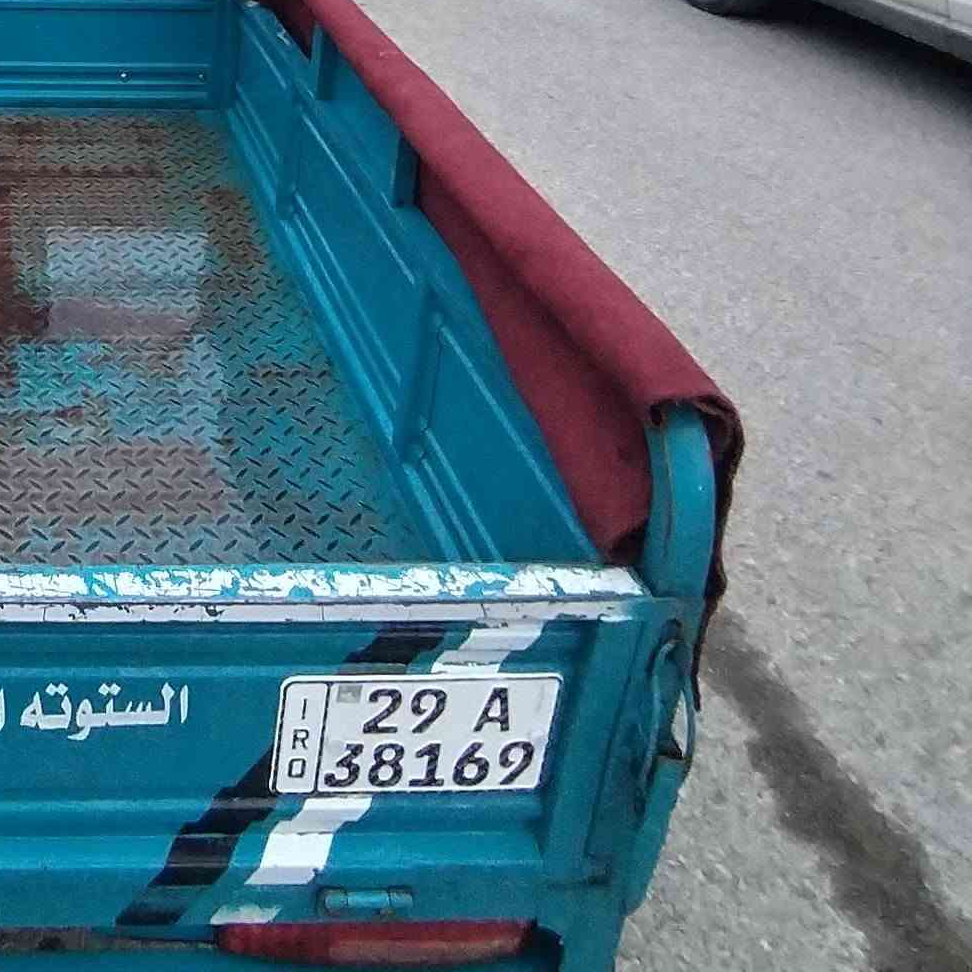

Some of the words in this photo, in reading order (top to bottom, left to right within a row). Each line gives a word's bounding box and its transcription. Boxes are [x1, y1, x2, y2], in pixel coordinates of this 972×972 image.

[19, 682, 189, 741] الستوته
[363, 688, 448, 734] 29
[474, 687, 510, 733] A
[324, 741, 535, 788] 38169
